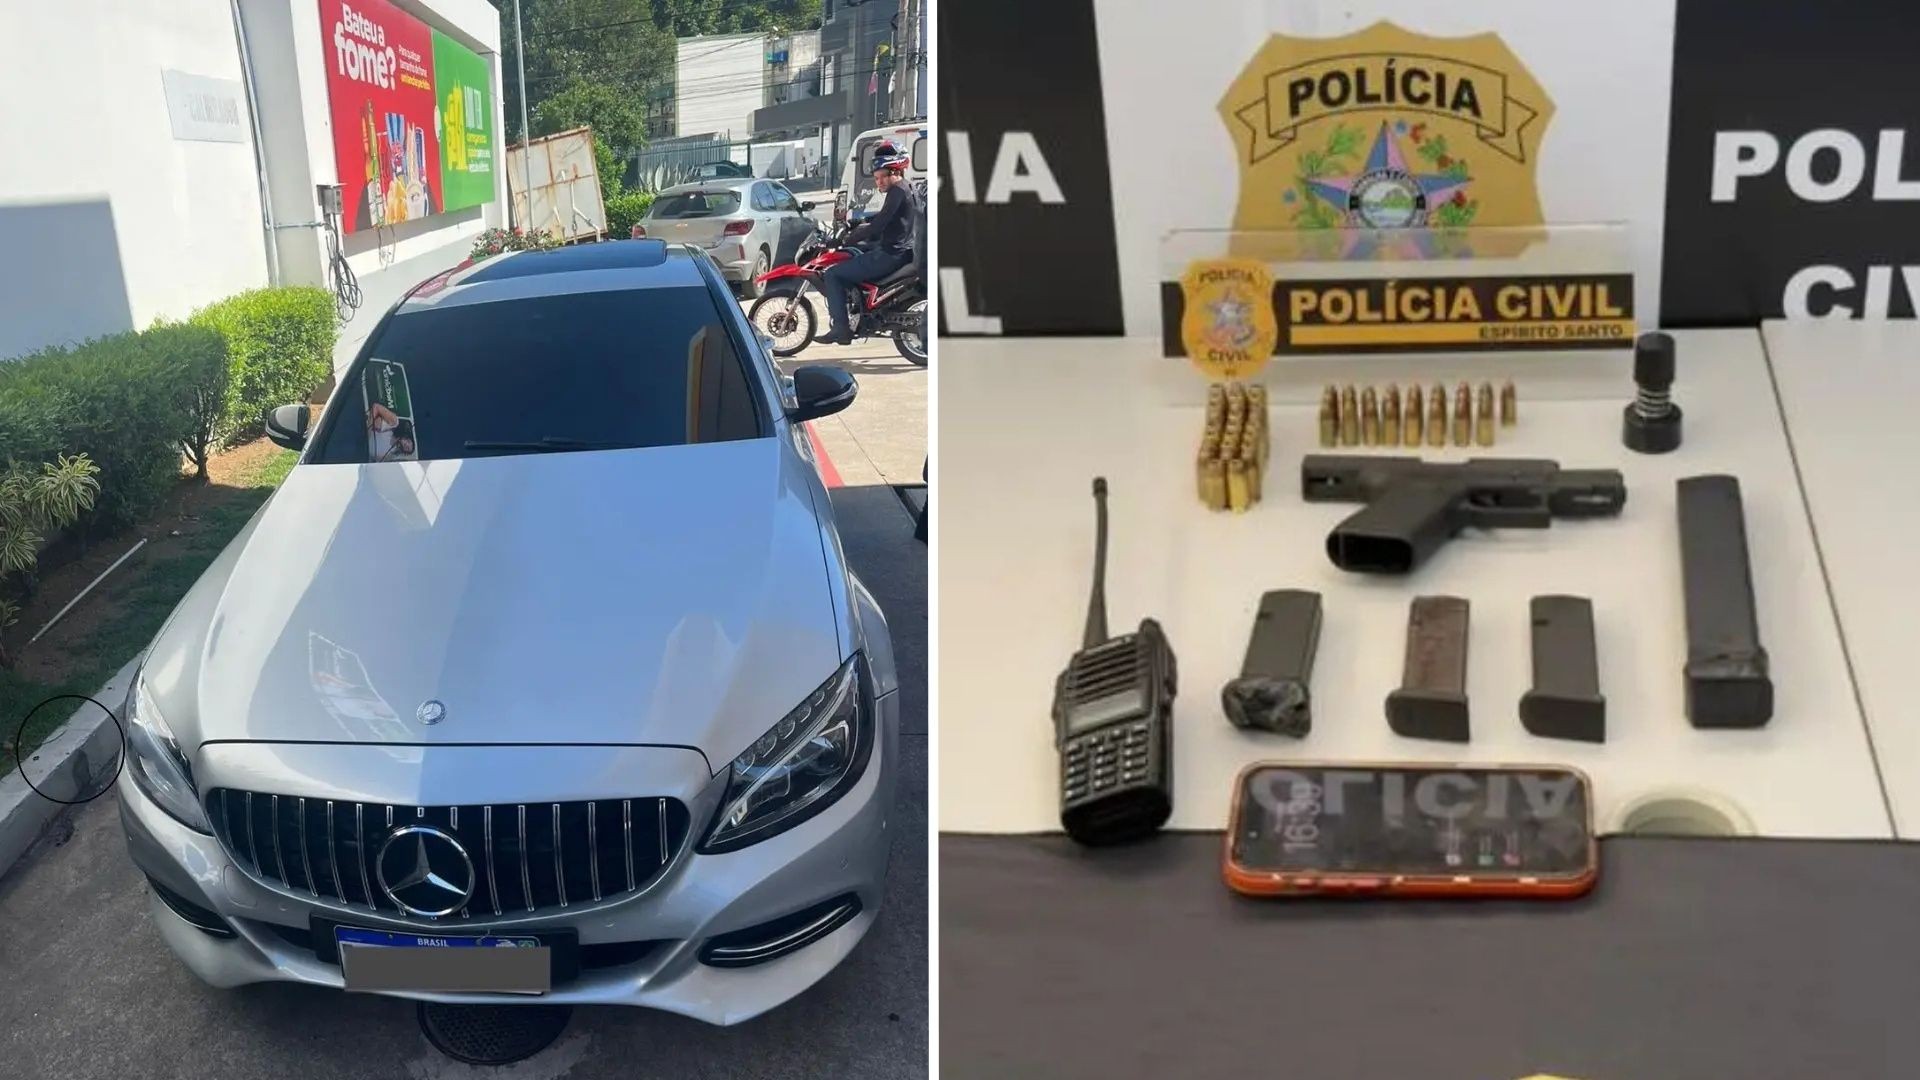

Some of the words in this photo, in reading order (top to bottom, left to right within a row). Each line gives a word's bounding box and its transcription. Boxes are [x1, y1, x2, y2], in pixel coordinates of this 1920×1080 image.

[343, 3, 378, 44] Bateu
[378, 25, 385, 47] a
[334, 21, 396, 90] fome?
[1288, 58, 1482, 119] POLÍCIA
[938, 131, 1066, 203] IA
[1711, 128, 1920, 202] POL
[1290, 280, 1482, 323] POLÍCIA
[1496, 283, 1623, 320] CIVIL
[1564, 323, 1623, 338] SANTO
[1207, 349, 1251, 361] CIVIL
[417, 937, 449, 948] BRASIL
